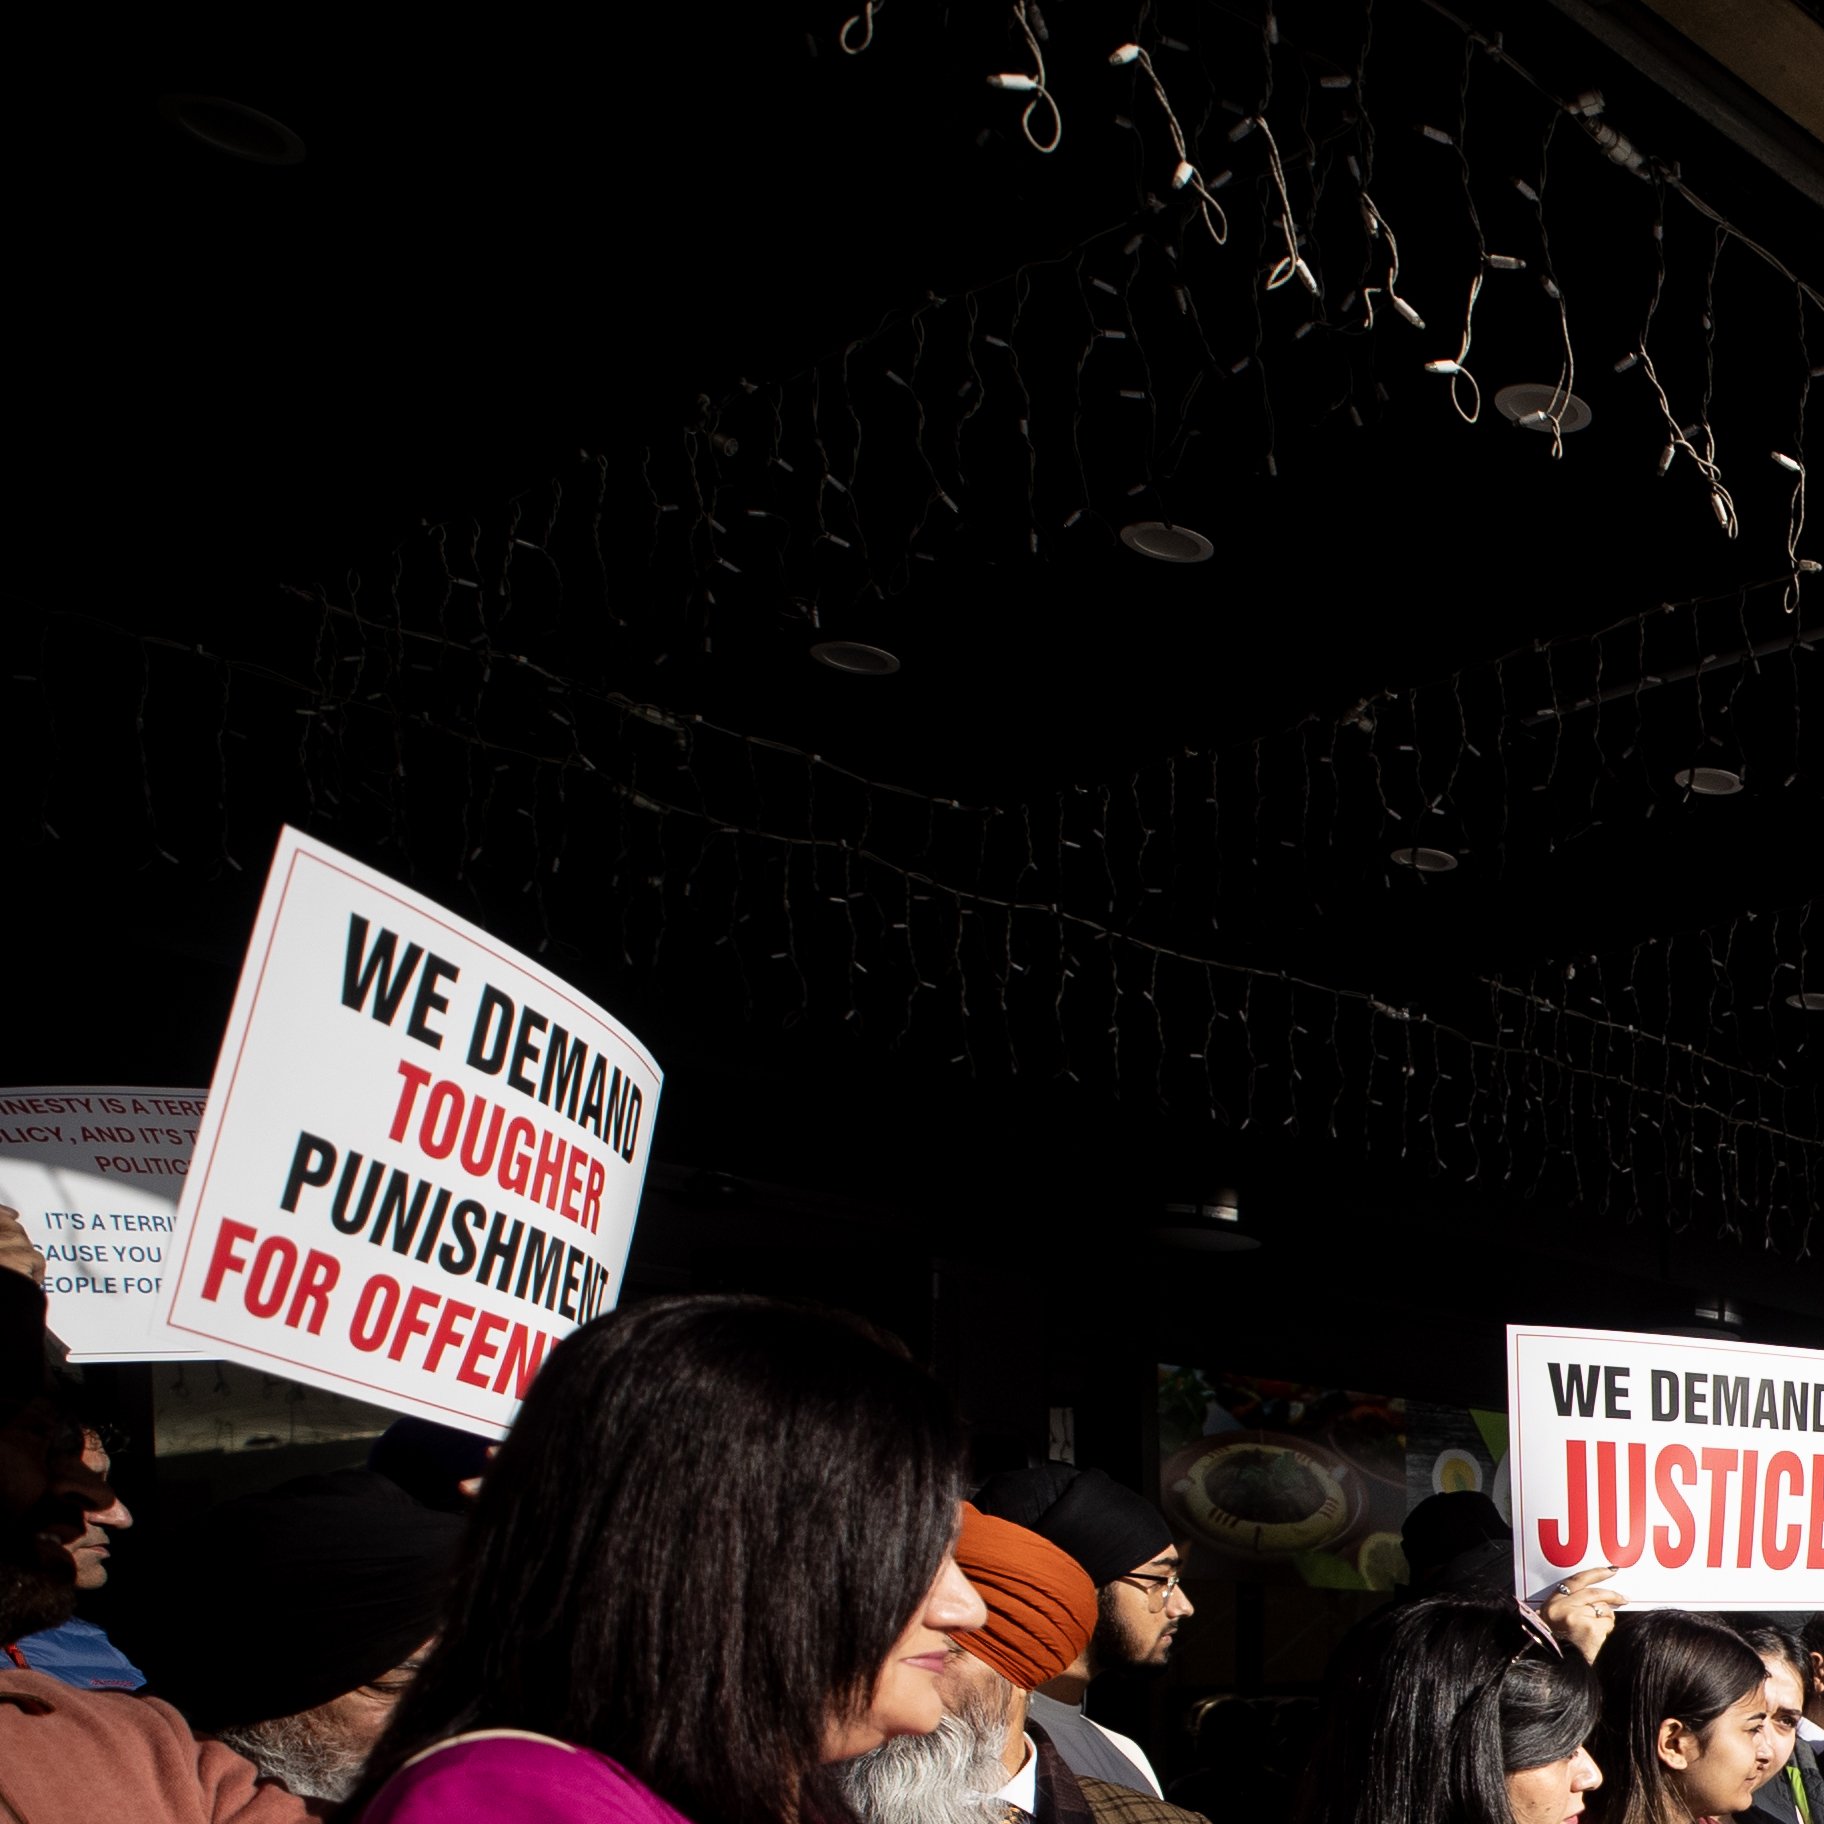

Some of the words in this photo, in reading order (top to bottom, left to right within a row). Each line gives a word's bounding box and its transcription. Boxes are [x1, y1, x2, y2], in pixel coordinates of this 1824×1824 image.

[341, 912, 461, 1051] WE
[465, 982, 645, 1165] DEMAND
[0, 1097, 94, 1116] NESTY
[97, 1098, 126, 1115] IS
[131, 1099, 152, 1115] A
[81, 1126, 136, 1144] AND
[141, 1127, 183, 1146] IT'S
[388, 1059, 607, 1235] TOUGHER
[95, 1155, 191, 1176] POLITIC
[45, 1212, 85, 1231] IT'S
[91, 1214, 106, 1231] A
[110, 1214, 177, 1233] TERRI
[280, 1130, 610, 1328] PUNISHMENT
[112, 1246, 162, 1263] YOU
[200, 1218, 341, 1337] FOR
[348, 1274, 565, 1401] OFFEN
[1547, 1362, 1631, 1421] WE
